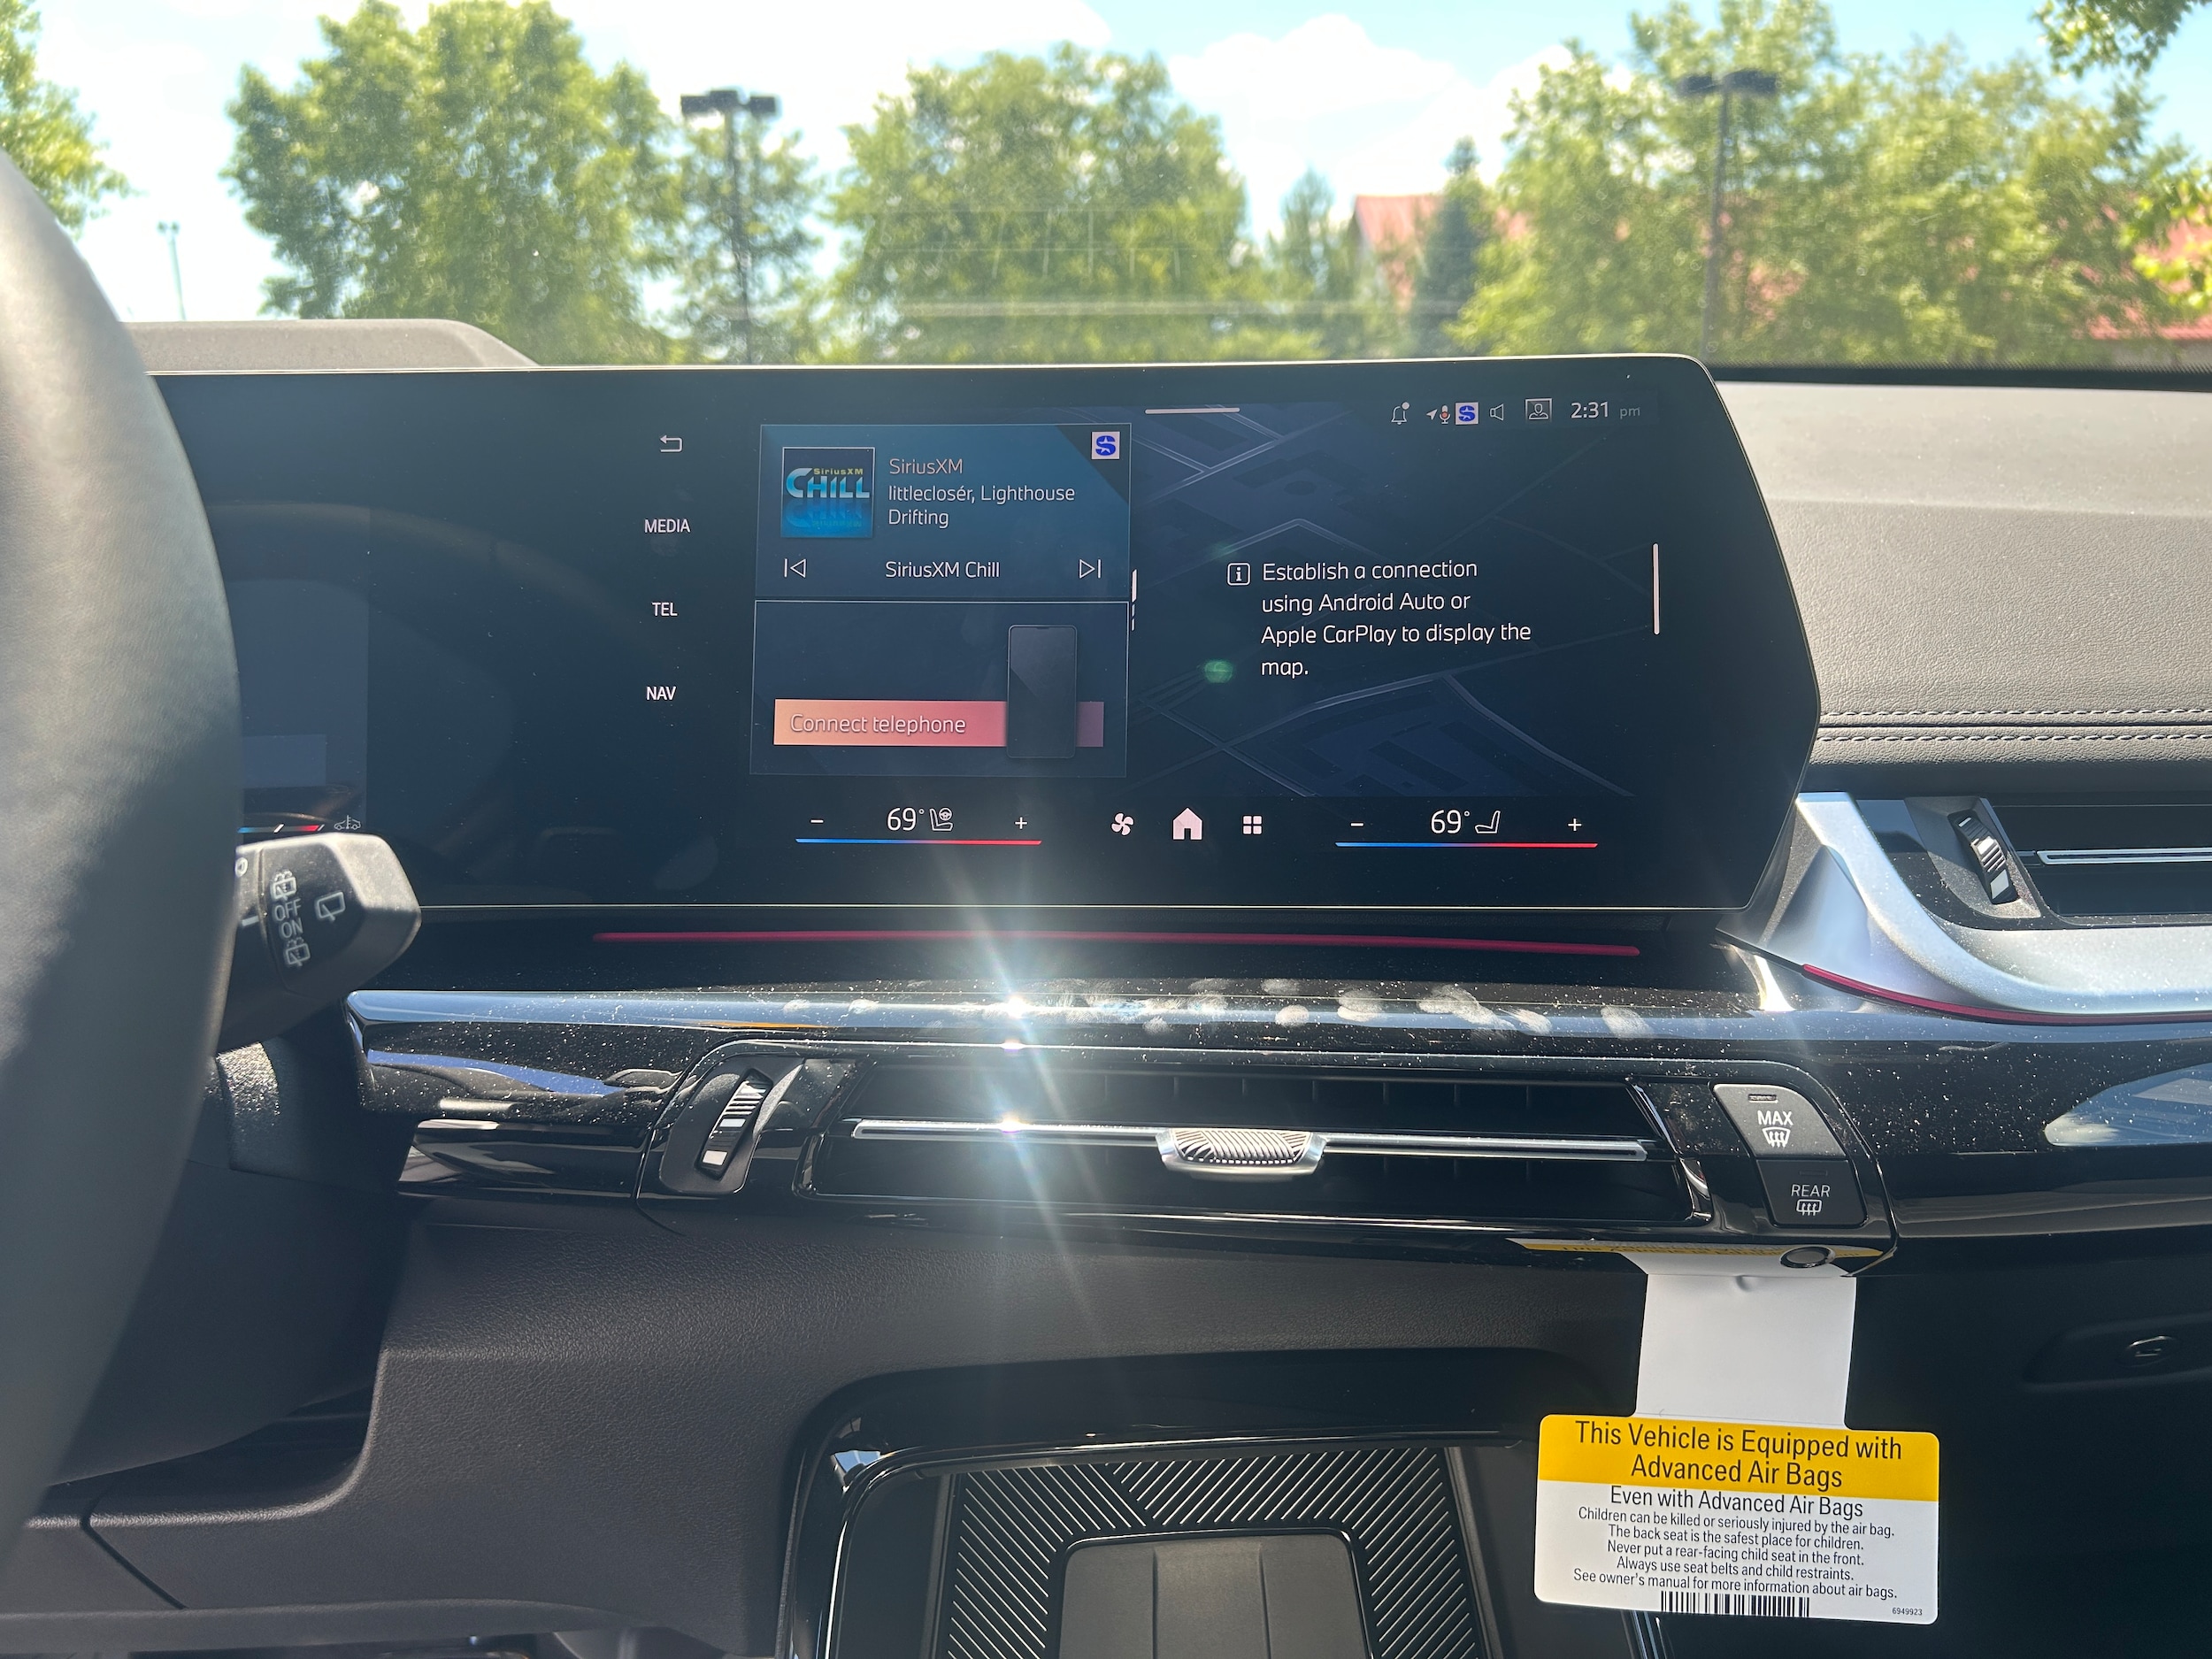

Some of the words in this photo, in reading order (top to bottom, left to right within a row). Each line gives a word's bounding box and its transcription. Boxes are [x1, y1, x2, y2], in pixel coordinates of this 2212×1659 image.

[1571, 402, 1609, 419] 2:31
[1619, 405, 1640, 419] pm
[889, 458, 964, 475] SiriusXM
[981, 485, 1075, 503] Lighthouse
[644, 518, 690, 534] MEDIA
[888, 509, 949, 528] Drifting
[885, 562, 959, 578] SiriusXM
[965, 561, 999, 578] Chill
[1263, 563, 1348, 580] Establish
[1355, 565, 1366, 580] a
[1372, 562, 1477, 579] connection
[653, 602, 677, 616] TEL
[1262, 596, 1313, 615] using
[1318, 594, 1394, 611] Android
[1400, 593, 1444, 610] Auto
[1451, 594, 1470, 609] or
[1262, 626, 1317, 648] Apple
[1323, 625, 1395, 645] CarPlay
[1402, 626, 1420, 641] to
[1426, 624, 1494, 642] display
[1501, 624, 1531, 640] the
[1261, 659, 1309, 679] map.
[646, 687, 676, 701] NAV
[791, 714, 867, 732] Connect
[872, 715, 965, 734] telephone
[274, 898, 301, 921] OFF
[281, 918, 303, 938] ON
[1757, 1110, 1793, 1125] MAX
[1792, 1185, 1830, 1196] REAR
[1575, 1420, 1621, 1444] This
[1628, 1423, 1709, 1449] Vehicle
[1717, 1428, 1733, 1451] is
[1742, 1430, 1848, 1460] Equipped
[1856, 1436, 1901, 1459] with
[1631, 1454, 1740, 1482] Advanced
[1747, 1460, 1779, 1484] Air
[1786, 1462, 1842, 1492] Bags
[1611, 1485, 1652, 1506] Even
[1657, 1489, 1694, 1509] with
[1699, 1490, 1785, 1513] Advanced
[1790, 1495, 1815, 1514] Air
[1819, 1496, 1863, 1521] Bags
[1578, 1507, 1626, 1522] Children
[1630, 1513, 1650, 1524] can
[1654, 1511, 1667, 1525] be
[1671, 1513, 1700, 1526] killed
[1703, 1517, 1715, 1526] or
[1718, 1516, 1769, 1532] seriously
[1772, 1518, 1810, 1535] injured
[1815, 1520, 1827, 1535] by
[1832, 1522, 1848, 1533] the
[1852, 1523, 1867, 1535] air
[1870, 1523, 1894, 1539] bag.
[1609, 1524, 1630, 1538] The
[1634, 1525, 1660, 1540] back
[1663, 1530, 1687, 1541] seat
[1691, 1530, 1700, 1542] is
[1703, 1531, 1721, 1542] the
[1724, 1532, 1758, 1545] safest
[1762, 1533, 1792, 1548] place
[1796, 1535, 1811, 1547] for
[1814, 1536, 1863, 1549] children.
[1608, 1540, 1641, 1554] Never
[1644, 1544, 1663, 1557] put
[1666, 1547, 1671, 1555] a
[1676, 1546, 1738, 1562] rear-facing
[1741, 1548, 1768, 1561] child
[1771, 1551, 1795, 1562] seat
[1799, 1551, 1809, 1563] in
[1812, 1551, 1830, 1563] the
[1833, 1552, 1863, 1565] front.
[1617, 1556, 1656, 1573] Always
[1661, 1562, 1680, 1571] use
[1684, 1563, 1708, 1573] seat
[1711, 1563, 1738, 1575] belts
[1742, 1564, 1762, 1576] and
[1766, 1565, 1792, 1578] child
[1796, 1567, 1853, 1580] restraints.
[1574, 1568, 1595, 1581] See
[1600, 1573, 1644, 1586] owner's
[1648, 1576, 1689, 1588] manual
[1693, 1576, 1709, 1589] for
[1712, 1580, 1740, 1591] more
[1745, 1579, 1809, 1594] information
[1813, 1583, 1845, 1595] about
[1848, 1586, 1862, 1596] air
[1866, 1586, 1897, 1600] bags.
